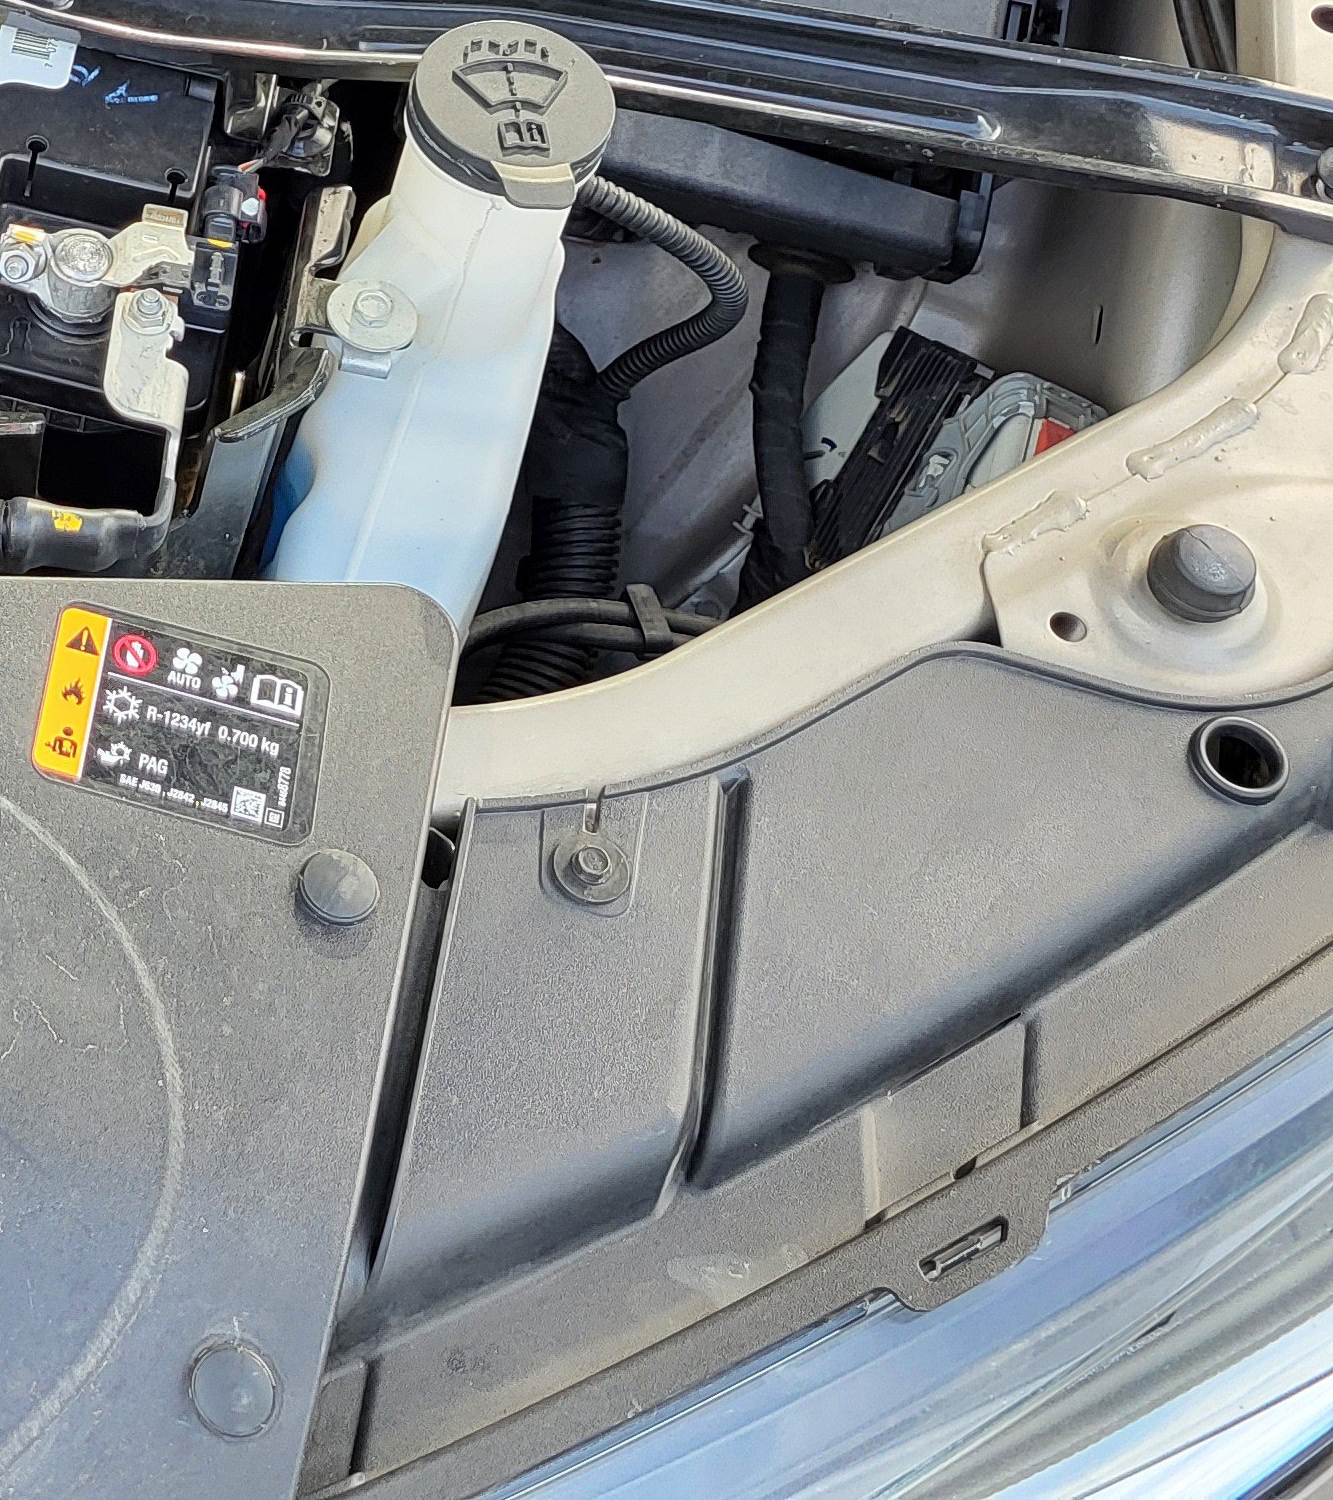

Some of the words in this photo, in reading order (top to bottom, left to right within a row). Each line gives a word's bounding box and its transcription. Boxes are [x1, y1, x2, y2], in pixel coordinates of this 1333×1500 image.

[167, 670, 201, 690] AUTO
[147, 705, 212, 736] R-1234yf
[218, 725, 258, 749] 0.700
[261, 736, 279, 757] kg
[138, 752, 168, 775] PAG
[119, 773, 139, 787] SAE
[201, 797, 229, 814] J2845
